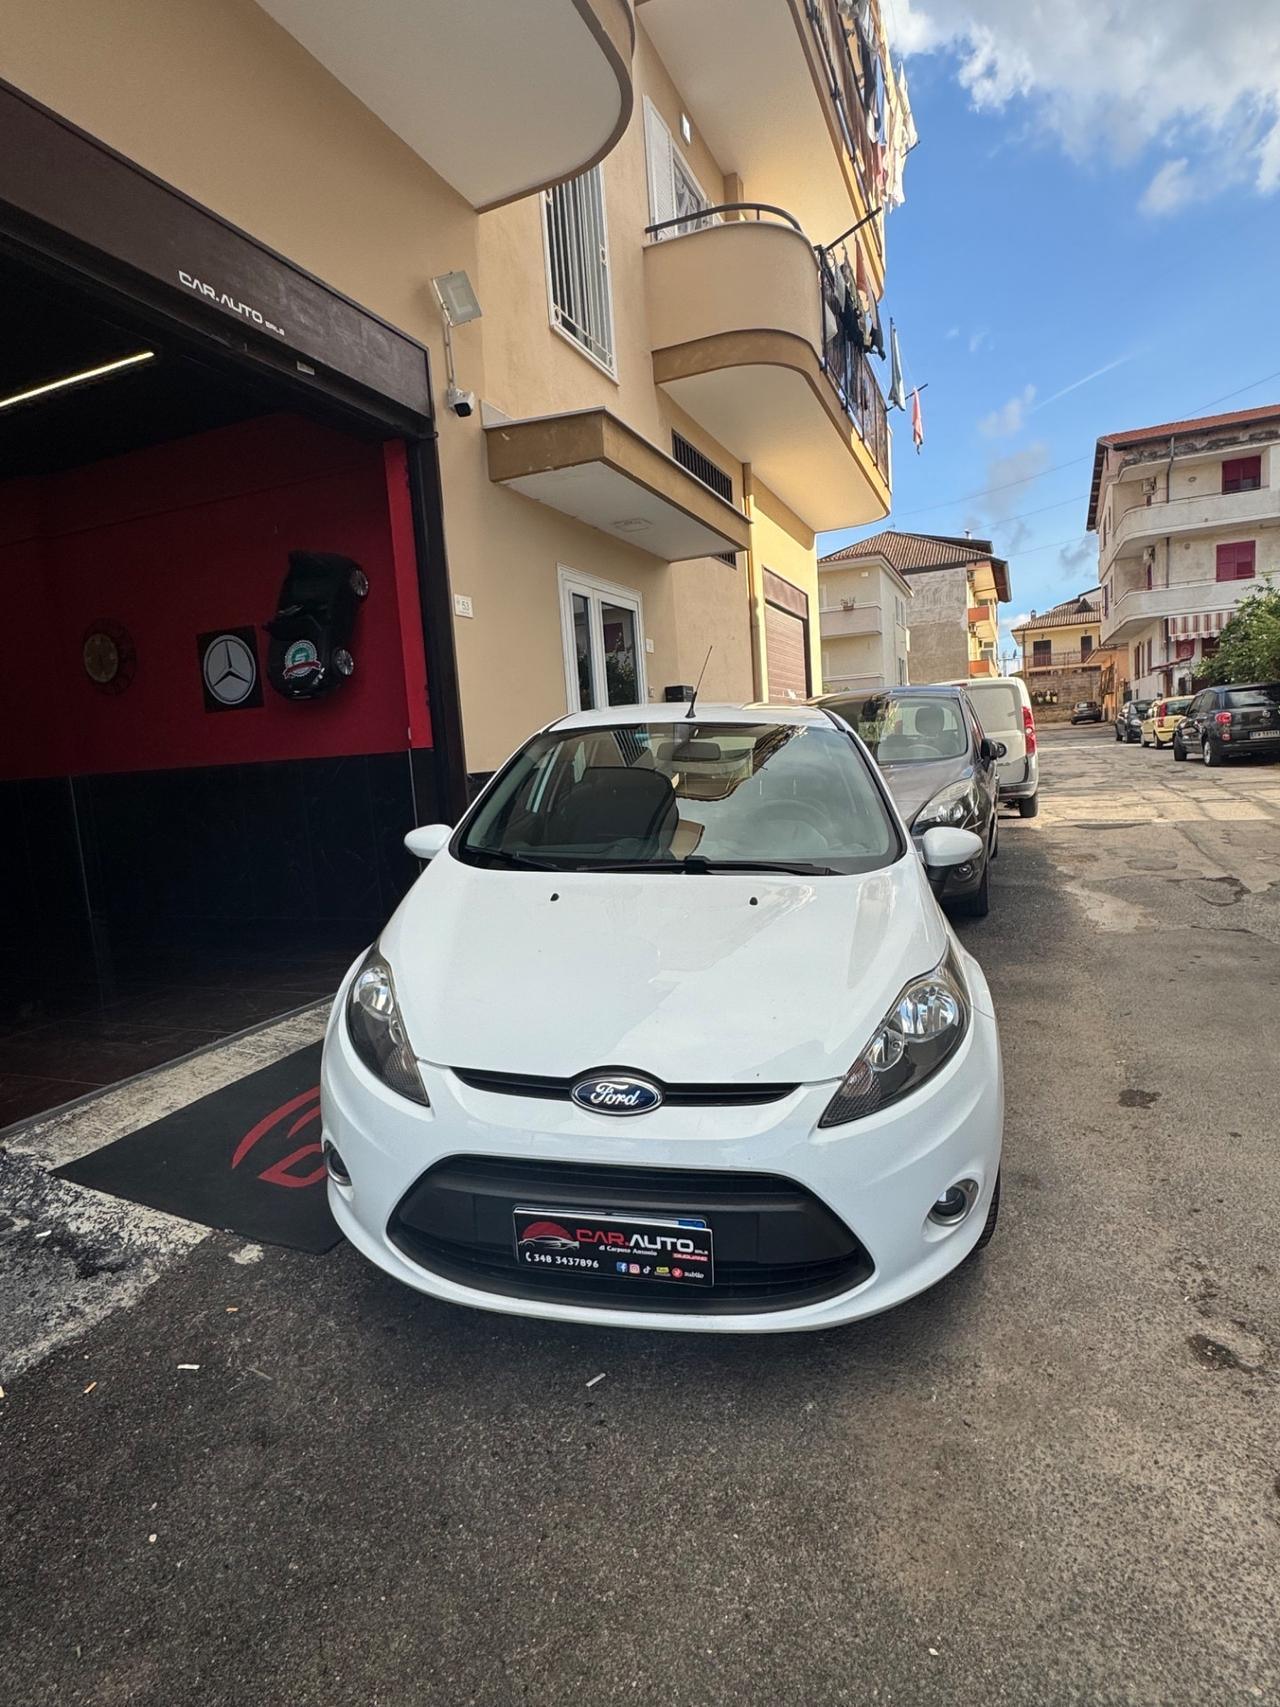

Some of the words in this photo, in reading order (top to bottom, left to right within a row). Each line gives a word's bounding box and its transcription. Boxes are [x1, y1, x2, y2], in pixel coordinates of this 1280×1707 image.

[590, 1082, 641, 1106] Ford
[533, 1253, 552, 1263] 348
[555, 1256, 600, 1268] 3437896
